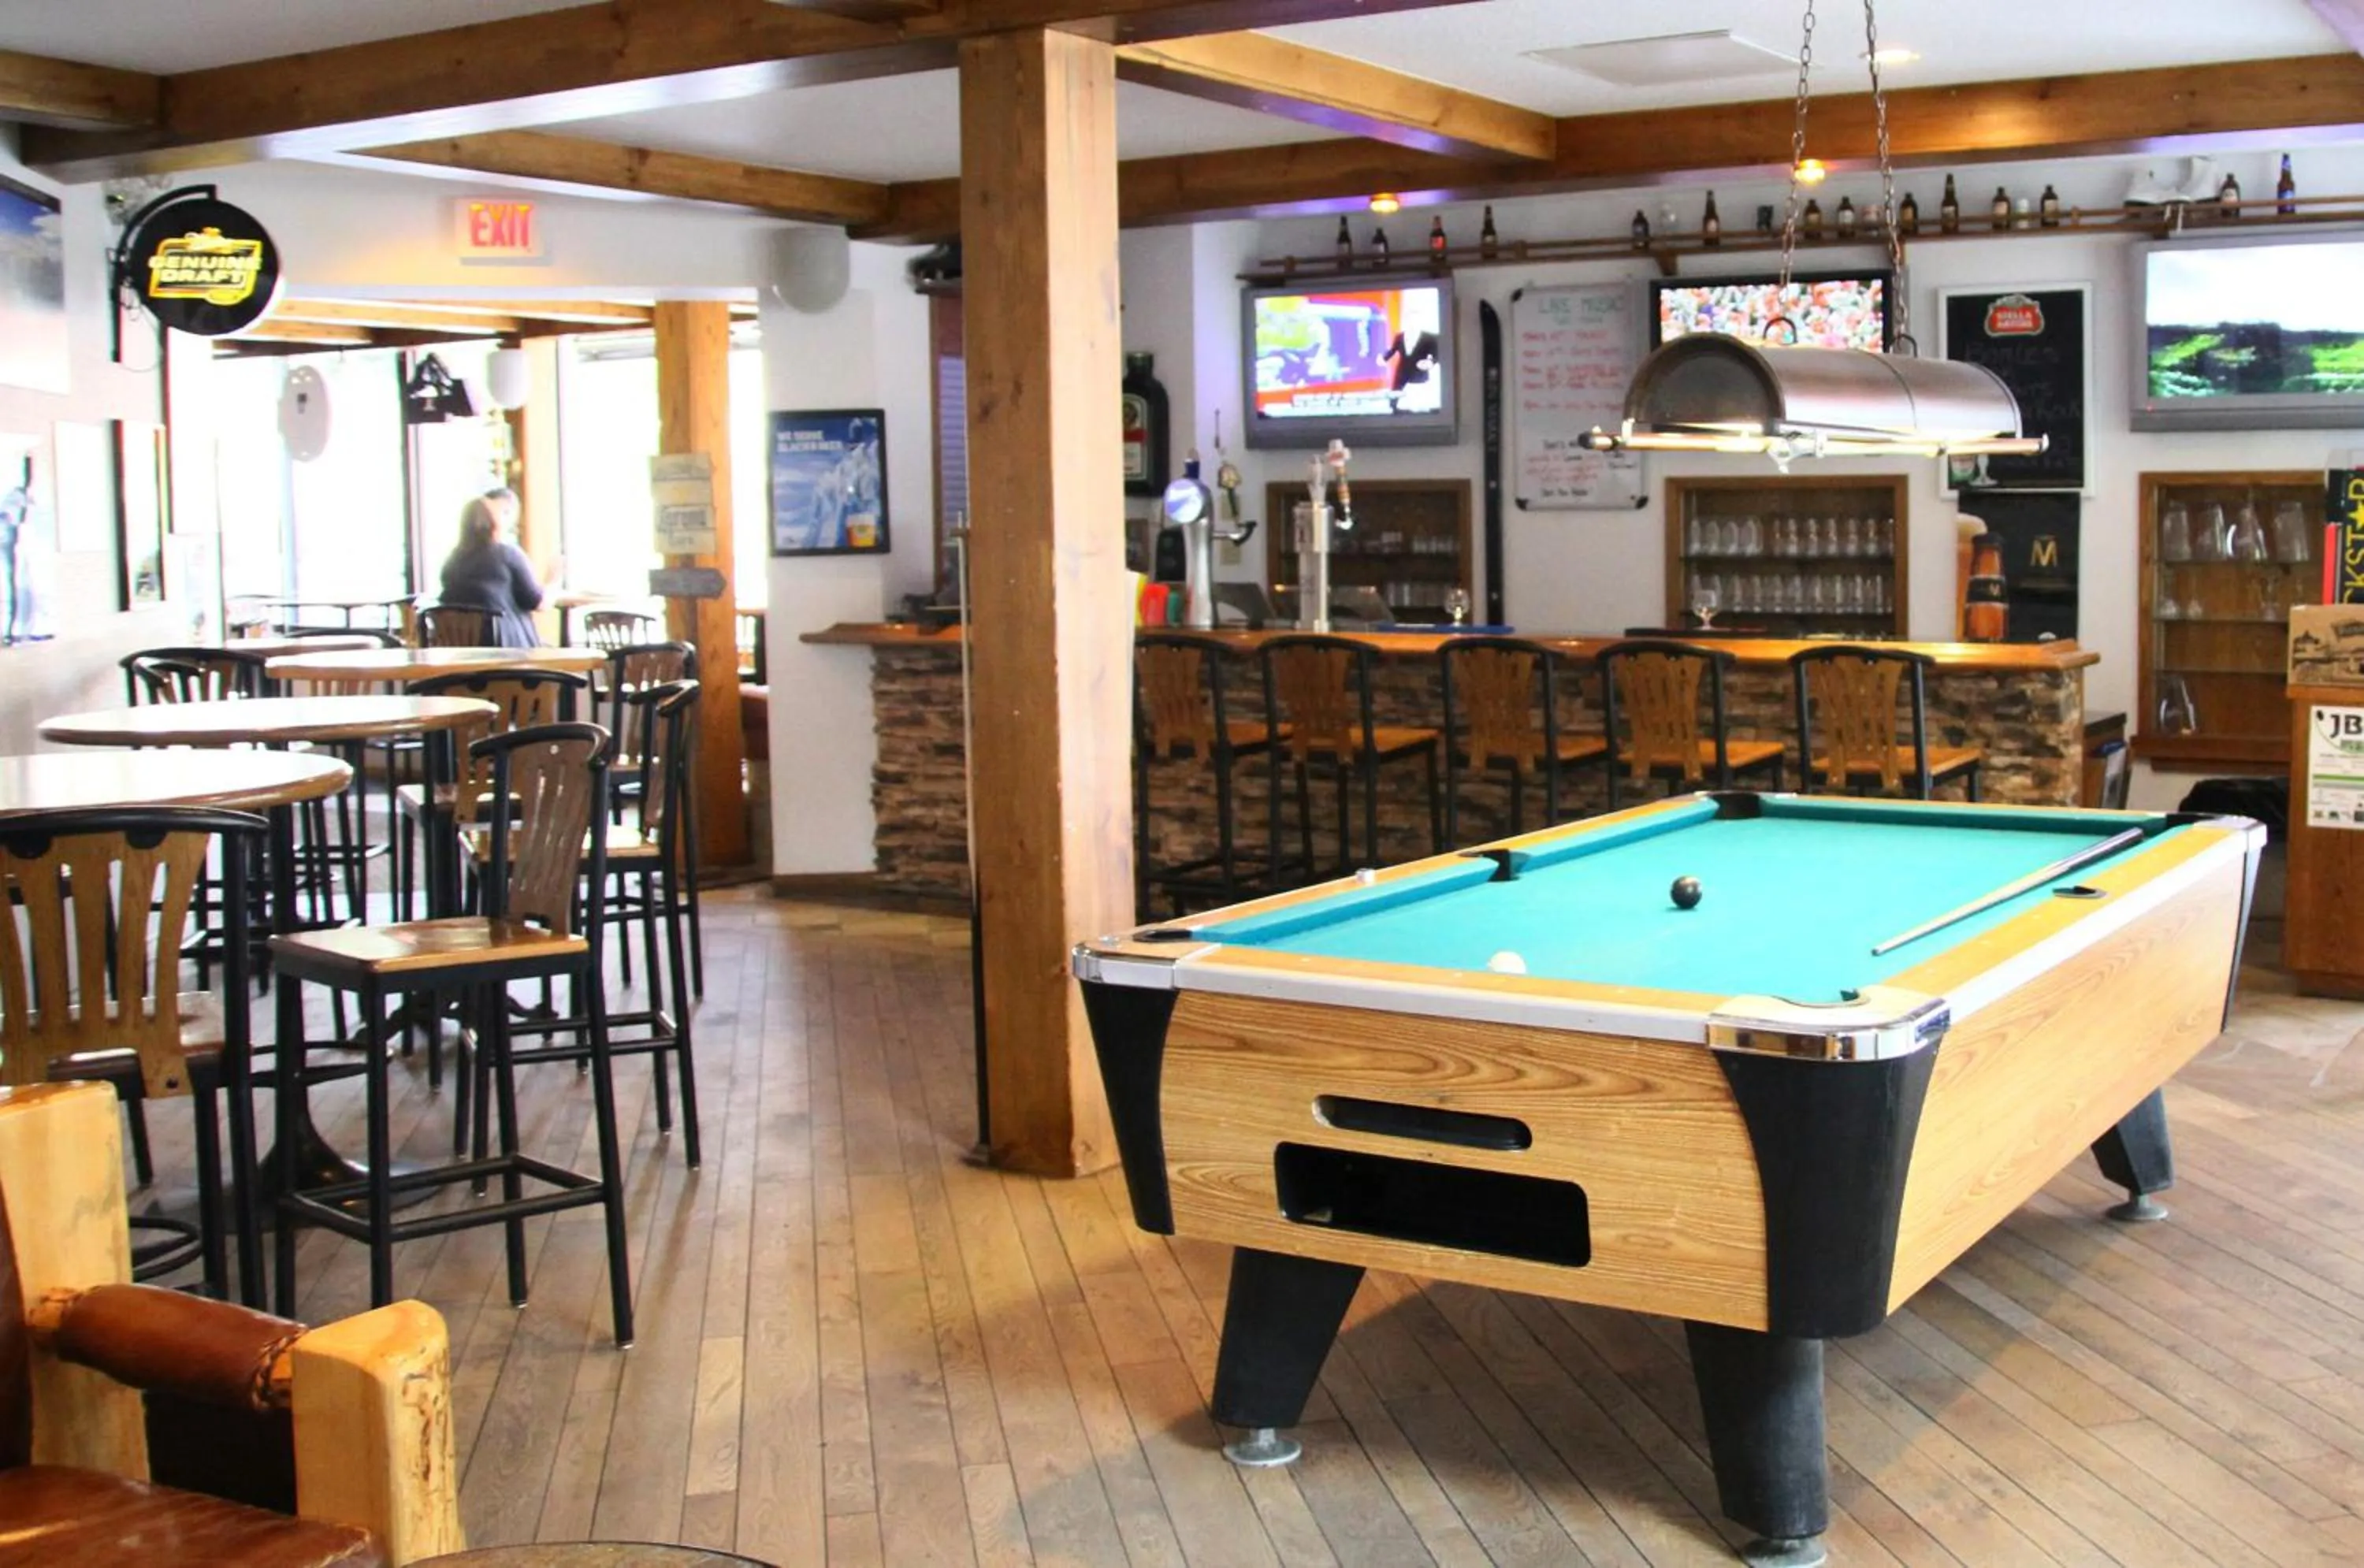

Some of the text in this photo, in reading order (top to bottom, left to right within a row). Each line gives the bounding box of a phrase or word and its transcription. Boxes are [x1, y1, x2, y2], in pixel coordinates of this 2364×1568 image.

[470, 203, 533, 247] EXIT
[148, 255, 262, 270] GENUINE
[160, 269, 240, 282] DRAFT
[2031, 539, 2057, 567] M
